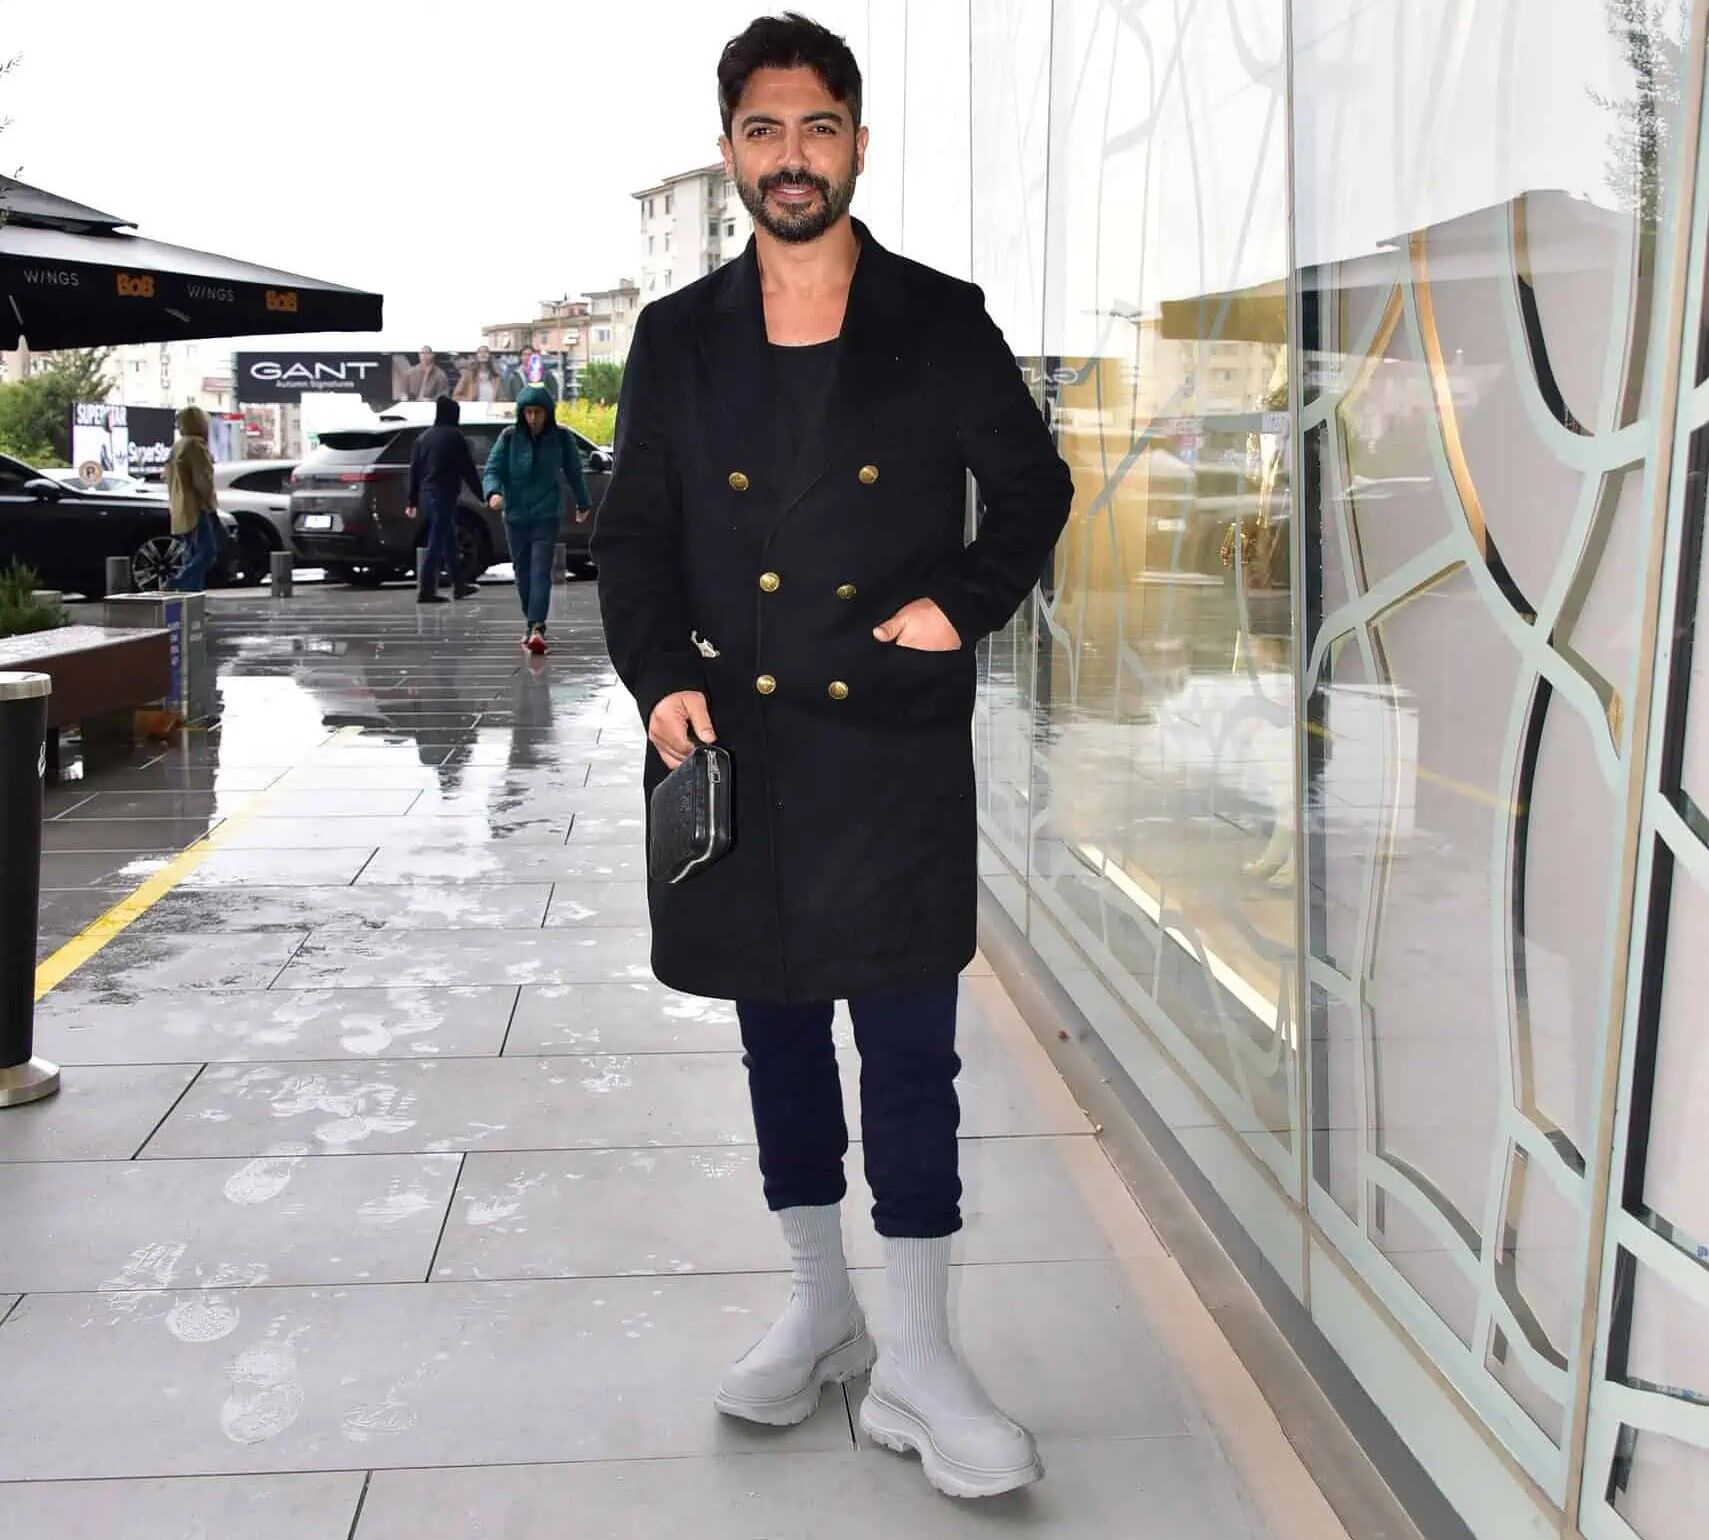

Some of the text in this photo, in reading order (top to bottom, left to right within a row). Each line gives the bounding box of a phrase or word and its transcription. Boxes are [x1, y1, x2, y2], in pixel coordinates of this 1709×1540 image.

[23, 269, 80, 287] WINGS
[187, 284, 235, 303] WINGS
[250, 361, 379, 380] GANT
